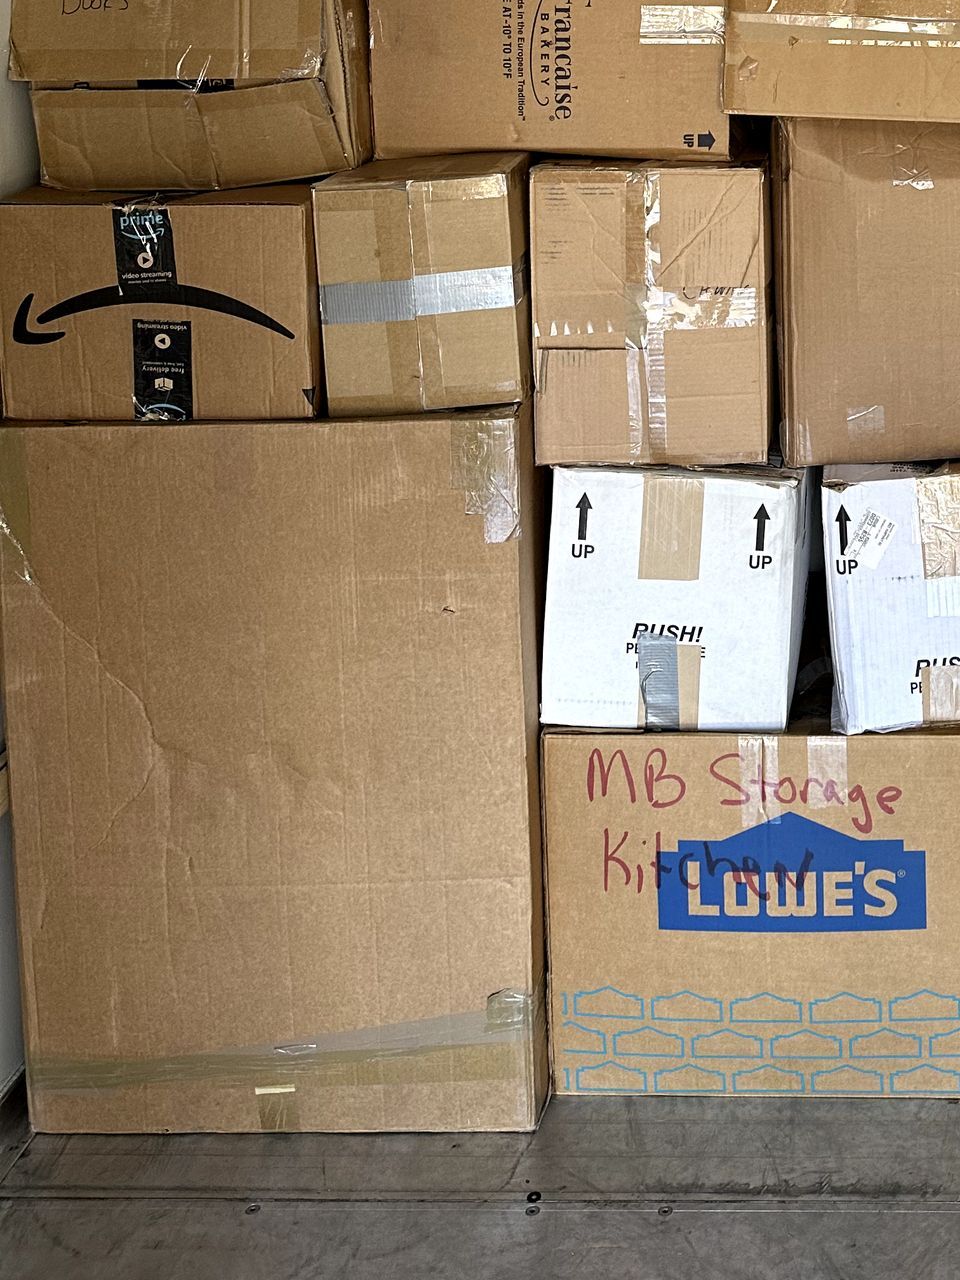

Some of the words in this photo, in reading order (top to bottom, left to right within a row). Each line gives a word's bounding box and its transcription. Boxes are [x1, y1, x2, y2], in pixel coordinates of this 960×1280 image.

[517, 11, 525, 20] in
[517, 21, 525, 35] the
[502, 42, 512, 54] TO
[540, 12, 551, 87] BAKERY
[515, 36, 526, 78] European
[683, 133, 694, 148] UP
[120, 212, 164, 230] prime
[121, 272, 139, 280] video
[140, 271, 173, 279] streaming
[137, 322, 169, 331] streaming
[169, 323, 188, 331] video
[142, 365, 170, 374] delivery
[171, 367, 185, 375] free
[571, 543, 595, 559] UP
[748, 554, 773, 570] UP
[835, 559, 859, 575] UP
[586, 747, 687, 809] MB
[708, 752, 904, 835] Storage
[687, 860, 899, 918] LOWE'S
